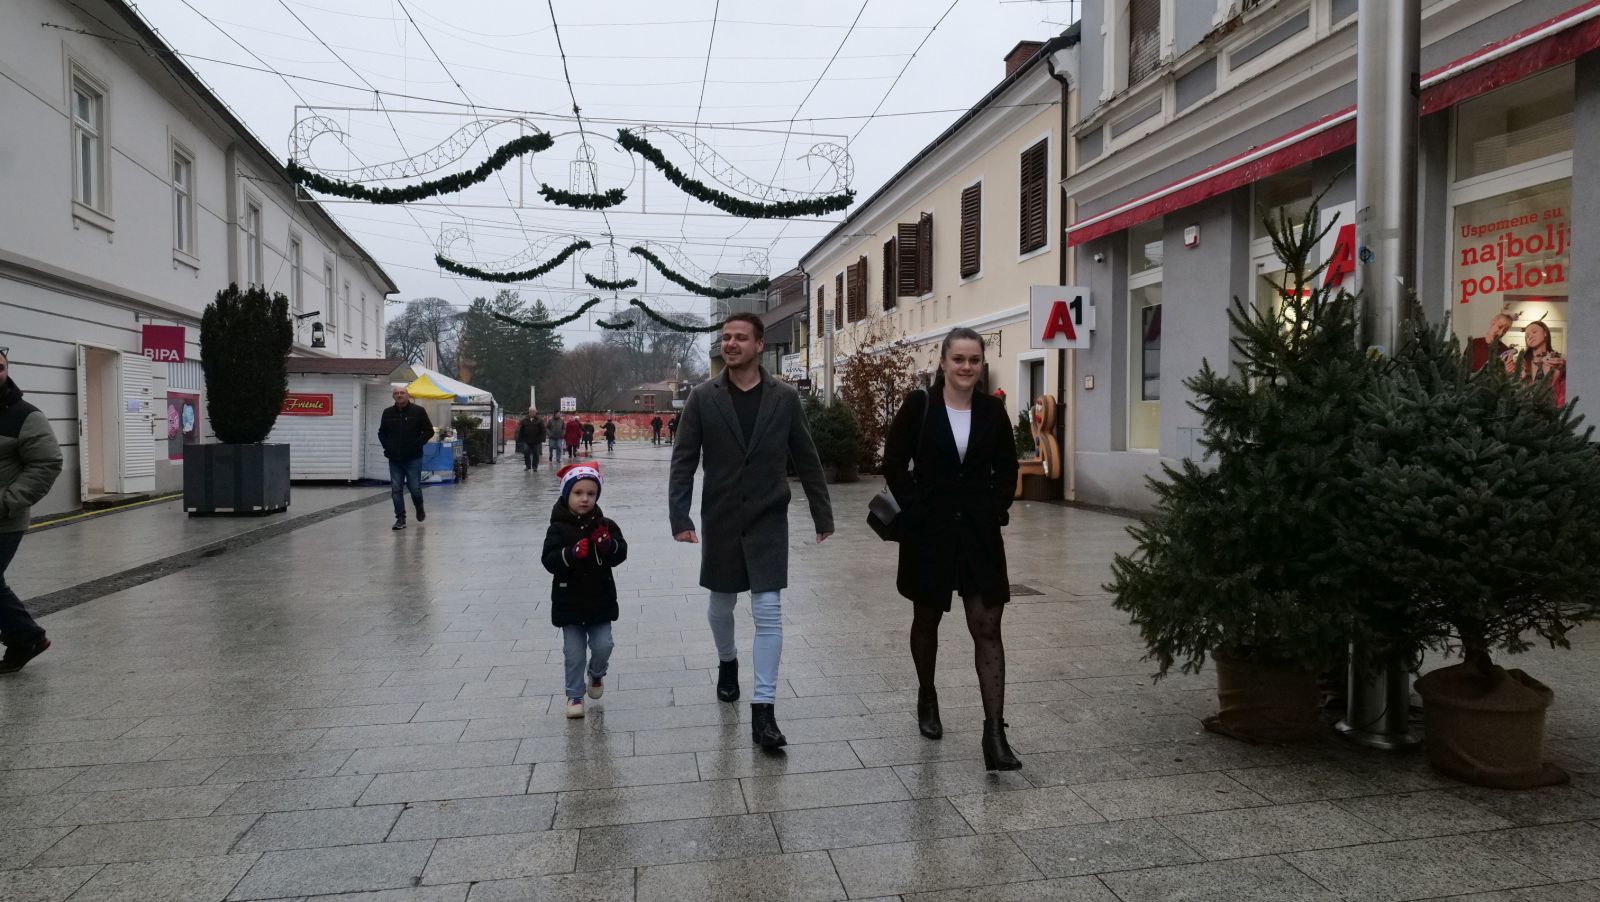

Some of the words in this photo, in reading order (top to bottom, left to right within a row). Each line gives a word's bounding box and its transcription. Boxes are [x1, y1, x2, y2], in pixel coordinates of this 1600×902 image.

[1461, 212, 1538, 239] Uspomene
[1543, 207, 1564, 220] su
[1460, 262, 1564, 304] poklon
[1042, 295, 1083, 341] A1
[143, 347, 180, 361] BIPA
